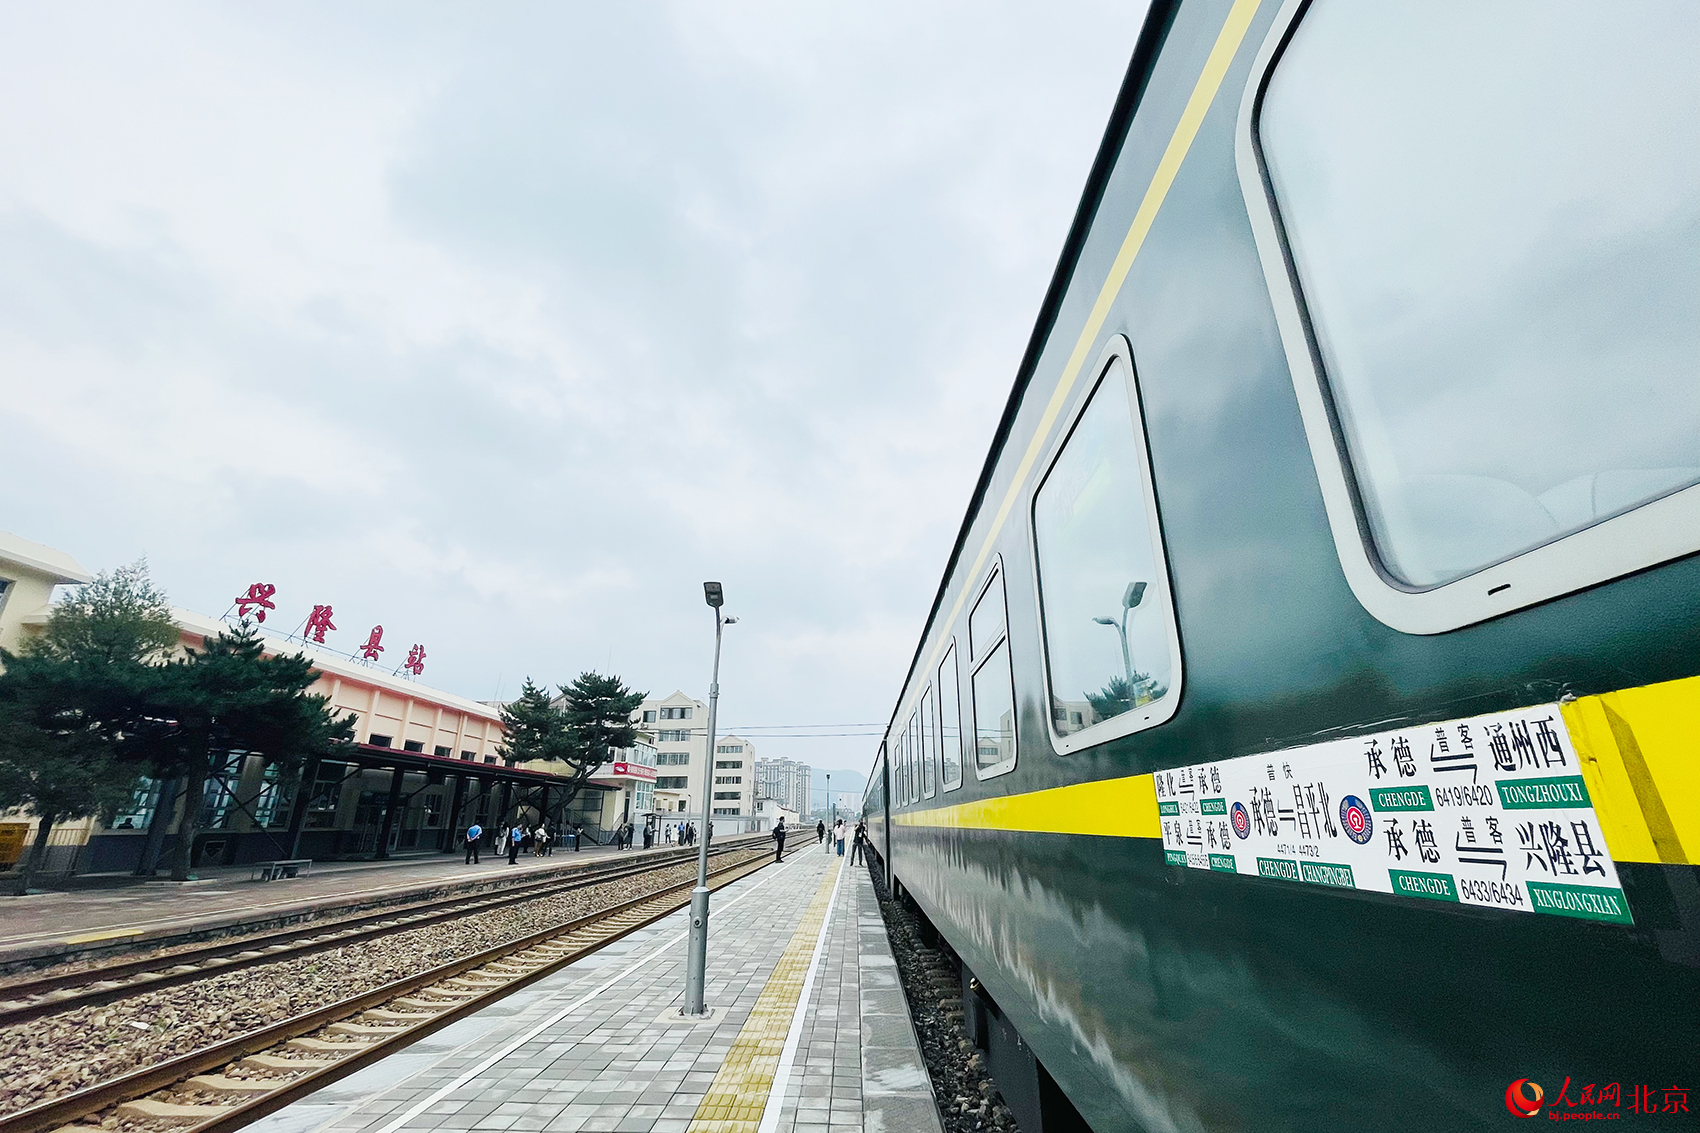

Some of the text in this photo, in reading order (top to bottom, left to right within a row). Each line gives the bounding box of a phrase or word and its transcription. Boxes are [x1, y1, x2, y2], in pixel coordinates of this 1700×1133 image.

[235, 582, 427, 676] 兴隆县站
[1363, 715, 1567, 780] 承德 通州西
[1435, 723, 1475, 753] 普客
[1198, 766, 1222, 795] 承德
[1378, 783, 1584, 808] CHENGDE 6419/6420 TONGZHOUXI
[1248, 781, 1338, 840] 承德 昌平北
[1206, 820, 1232, 850] 承德
[1461, 815, 1504, 845] 普客
[1383, 817, 1606, 878] 承德 兴隆县
[1260, 860, 1354, 888] CHENGDE CHANGPINGBEI
[1398, 875, 1622, 916] CHENGDE 6433/6434 XINGLONGXIAN
